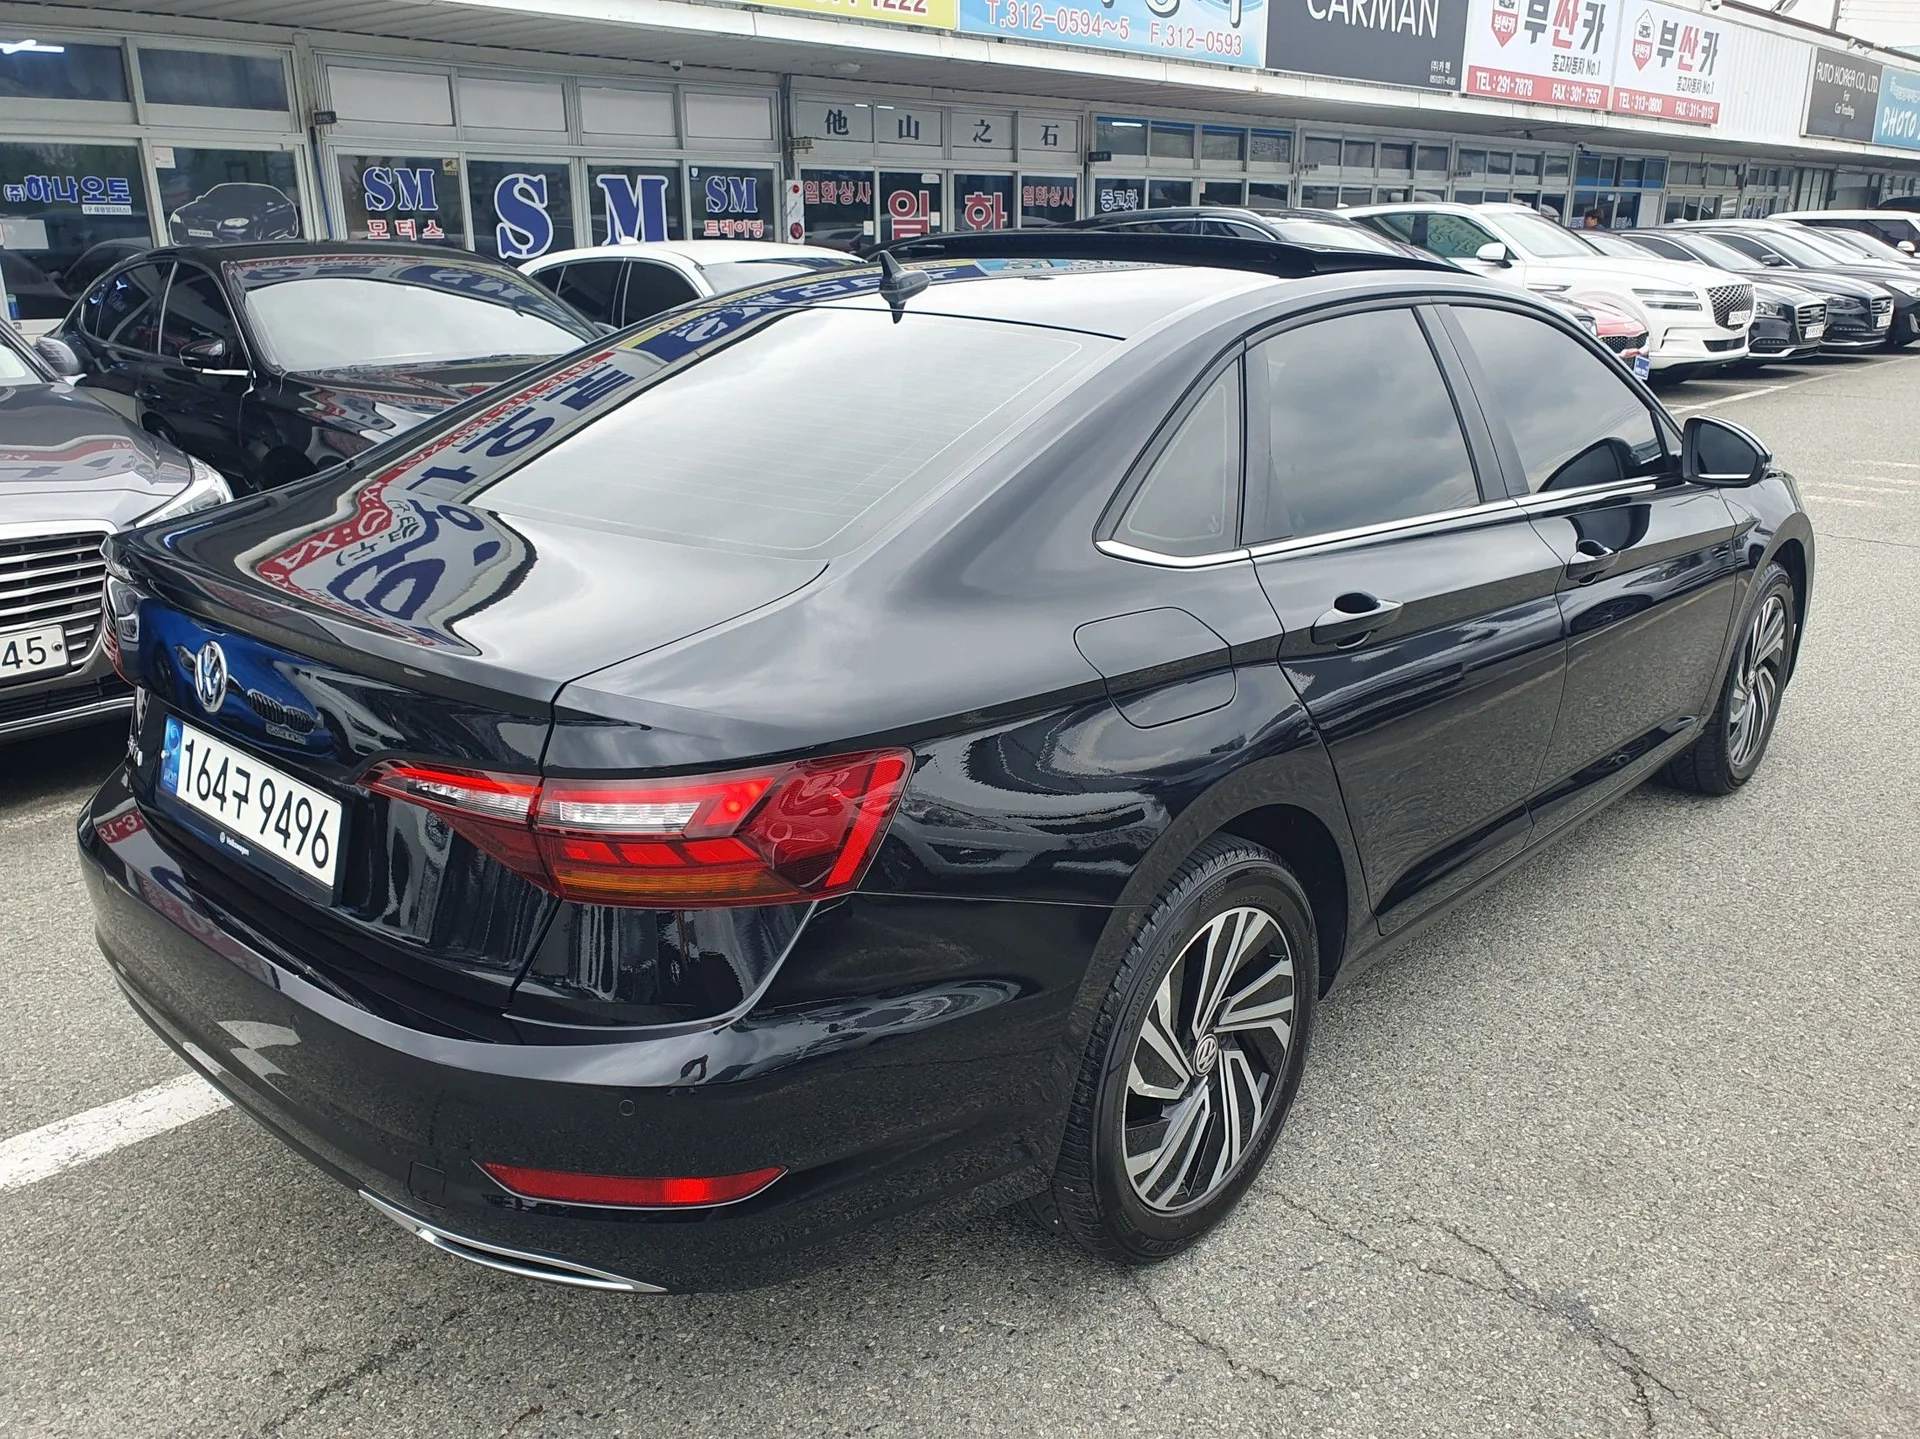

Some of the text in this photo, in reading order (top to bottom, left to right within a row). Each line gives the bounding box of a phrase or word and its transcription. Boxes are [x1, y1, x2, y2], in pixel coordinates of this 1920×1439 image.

[1150, 22, 1242, 56] F.312-0593
[1657, 20, 1719, 76] 부산카
[363, 167, 439, 211] SM
[705, 176, 758, 213] SM
[805, 181, 872, 204] 일화상사
[1100, 188, 1139, 212] 중고차
[366, 218, 445, 241] 모터스
[703, 219, 764, 239] 트레이딩
[1, 636, 47, 669] 45
[185, 739, 329, 869] 164구 9496
